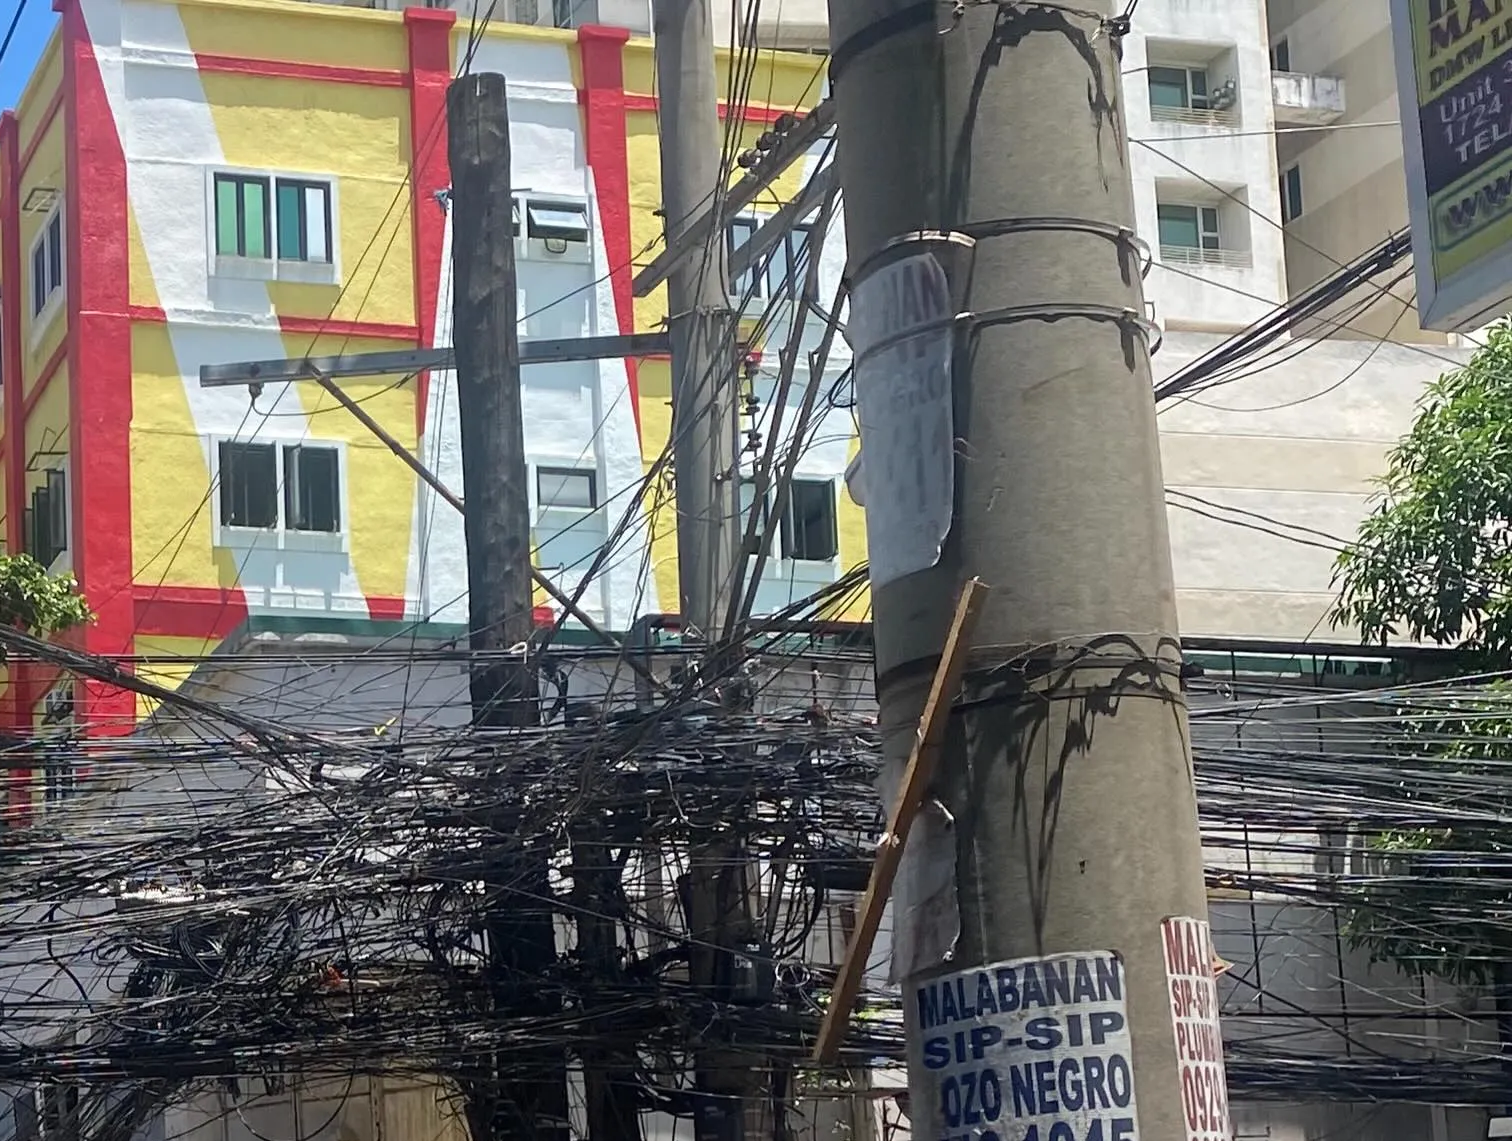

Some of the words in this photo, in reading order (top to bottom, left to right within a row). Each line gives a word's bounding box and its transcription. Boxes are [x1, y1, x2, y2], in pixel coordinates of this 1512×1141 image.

[1440, 75, 1494, 123] Unit
[1445, 93, 1503, 145] 1724
[917, 957, 1122, 1029] MALABANAN
[923, 1011, 1124, 1069] SIP-SIP
[943, 1068, 1001, 1128] OZO
[1011, 1054, 1131, 1118] NEGRO
